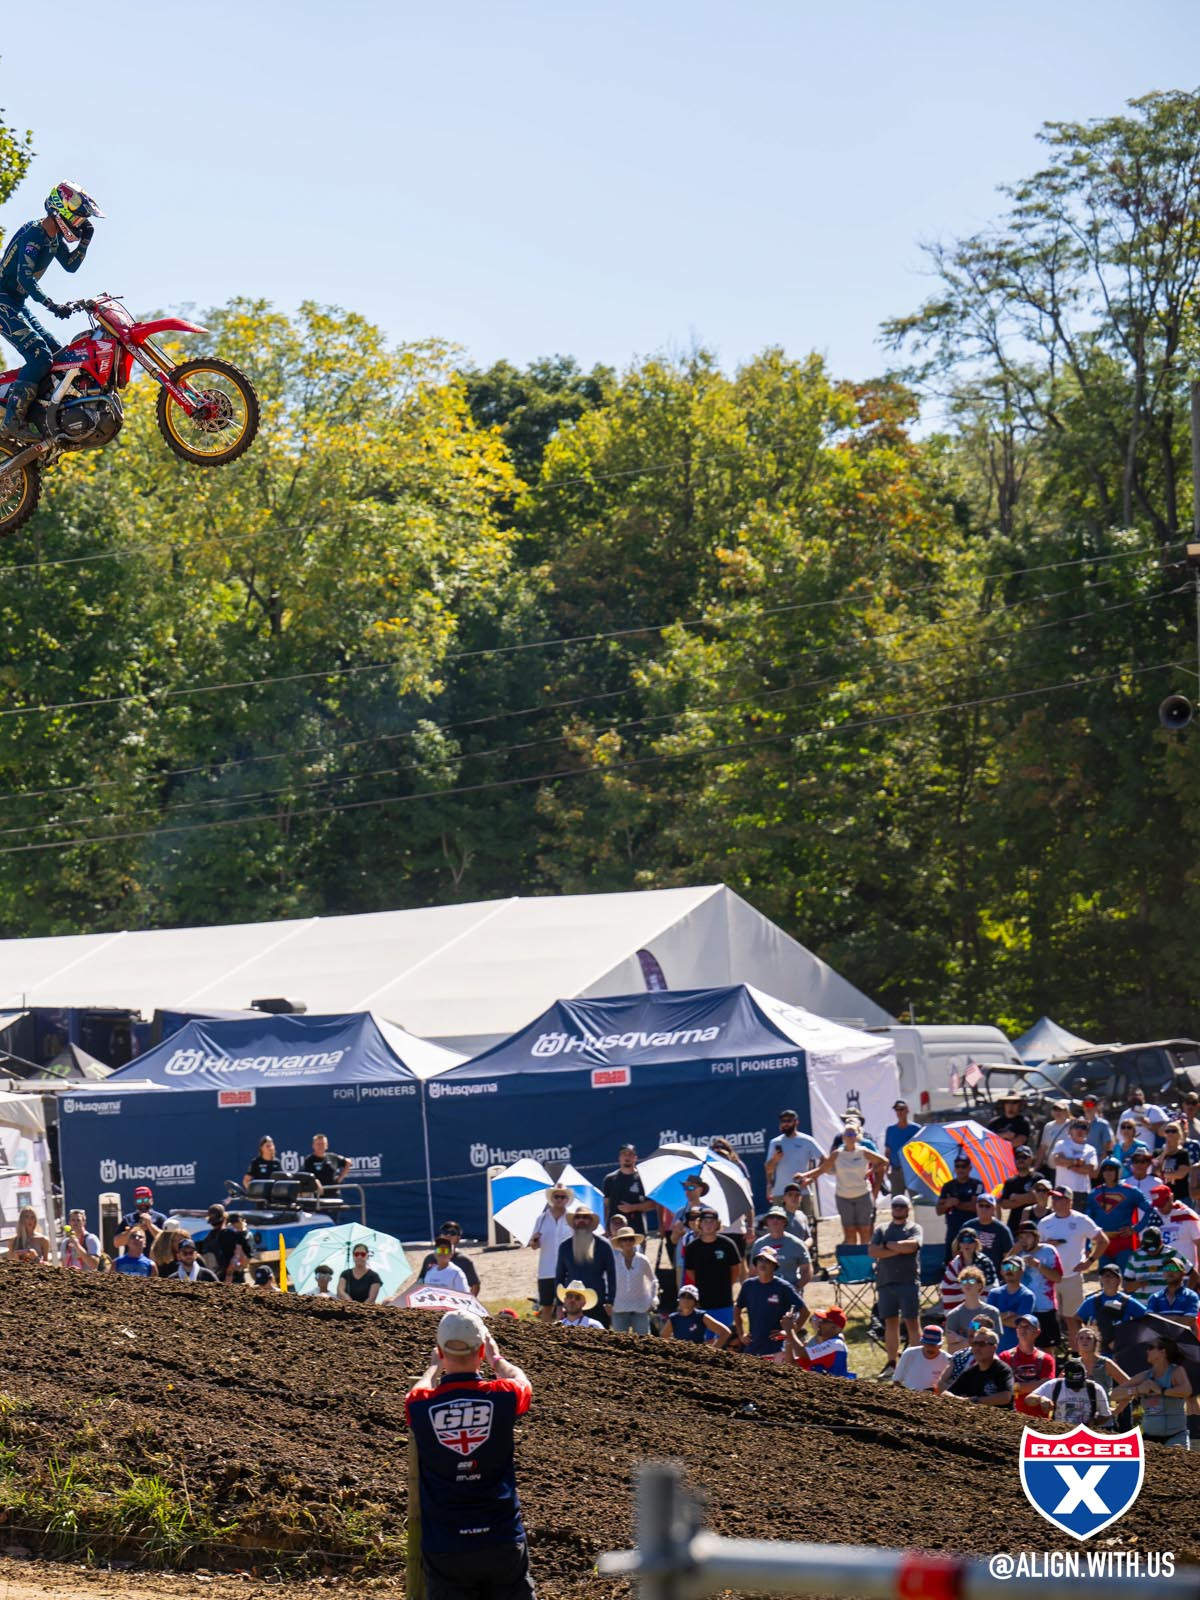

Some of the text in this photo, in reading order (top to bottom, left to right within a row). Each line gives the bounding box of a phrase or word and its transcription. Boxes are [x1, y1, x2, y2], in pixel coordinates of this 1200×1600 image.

[563, 1026, 721, 1053] Husqvarna
[199, 1049, 344, 1073] Husqvarna
[711, 1057, 799, 1074] FOR PIONEERS
[333, 1085, 416, 1099] FOR PIONEERS
[440, 1083, 498, 1096] Husqvarna
[75, 1100, 121, 1112] Husqvarna
[489, 1147, 571, 1164] Husqvarna
[118, 1163, 195, 1180] Husqvarna
[434, 1405, 491, 1430] GB
